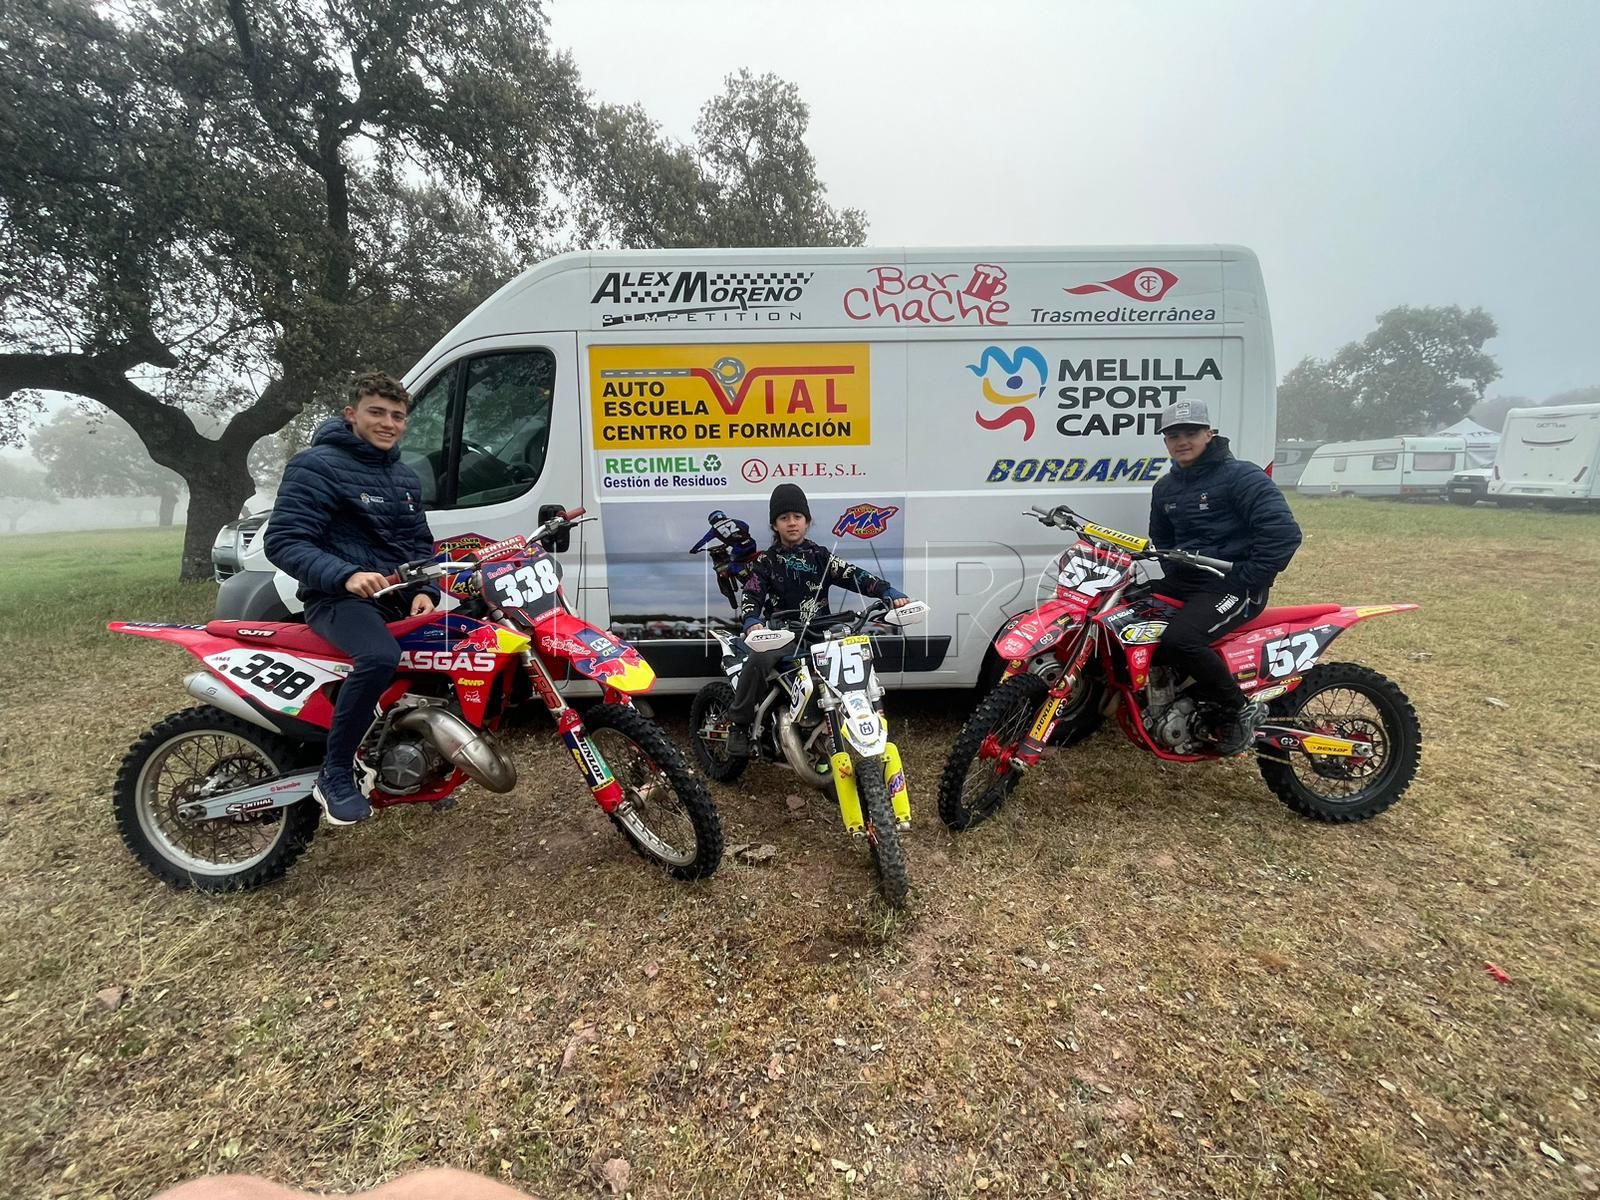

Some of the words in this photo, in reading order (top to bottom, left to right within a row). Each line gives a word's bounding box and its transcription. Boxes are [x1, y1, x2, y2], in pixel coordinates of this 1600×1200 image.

[591, 272, 674, 304] ALEX
[668, 272, 804, 311] MORENO
[867, 267, 959, 295] Bar
[1057, 358, 1223, 381] MELILLA
[602, 381, 665, 398] AUTO
[692, 365, 855, 416] VIAL
[1057, 385, 1187, 409] SPORT
[603, 400, 710, 417] ESCUELA
[602, 424, 688, 442] CENTRO
[694, 423, 722, 440] DE
[728, 418, 852, 439] FORMACIÓN
[1056, 413, 1164, 437] CAPIT
[605, 456, 701, 475] RECIMEL
[603, 475, 652, 489] Gestión
[653, 475, 671, 488] de
[1090, 523, 1141, 546] RENTHAL
[494, 558, 560, 608] 338
[398, 651, 497, 673] ASGAS
[822, 646, 865, 687] 75
[1265, 632, 1320, 678] 52
[229, 653, 316, 700] 338
